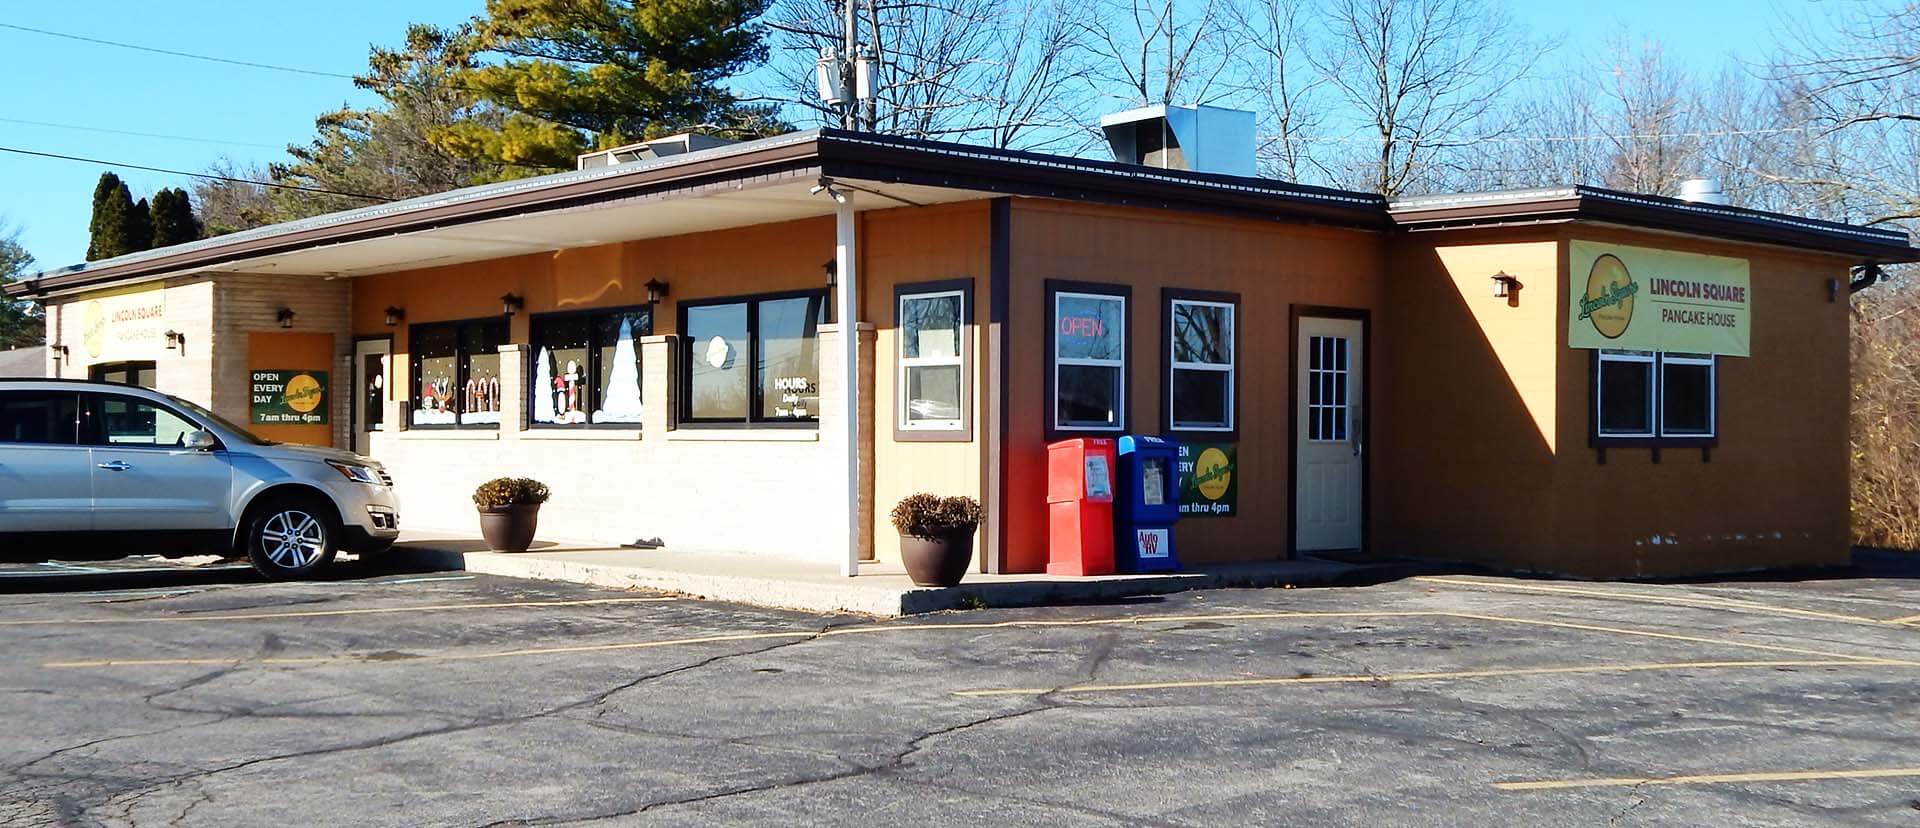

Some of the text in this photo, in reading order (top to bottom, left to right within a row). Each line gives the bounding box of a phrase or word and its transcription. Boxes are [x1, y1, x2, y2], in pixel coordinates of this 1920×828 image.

[1650, 278, 1745, 303] LINCOLN SQUARE
[1662, 309, 1736, 328] PANCAKE HOUSE
[1061, 316, 1103, 337] OPEN
[253, 373, 279, 381] OPEN
[253, 384, 284, 392] EVERY
[775, 377, 807, 389] HOURS
[253, 395, 272, 403] DAY
[260, 414, 321, 423] 7am thru 4pm
[1179, 446, 1189, 457] EN
[1179, 462, 1194, 473] ERY
[1192, 502, 1210, 513] thru
[1211, 502, 1230, 515] 4pm
